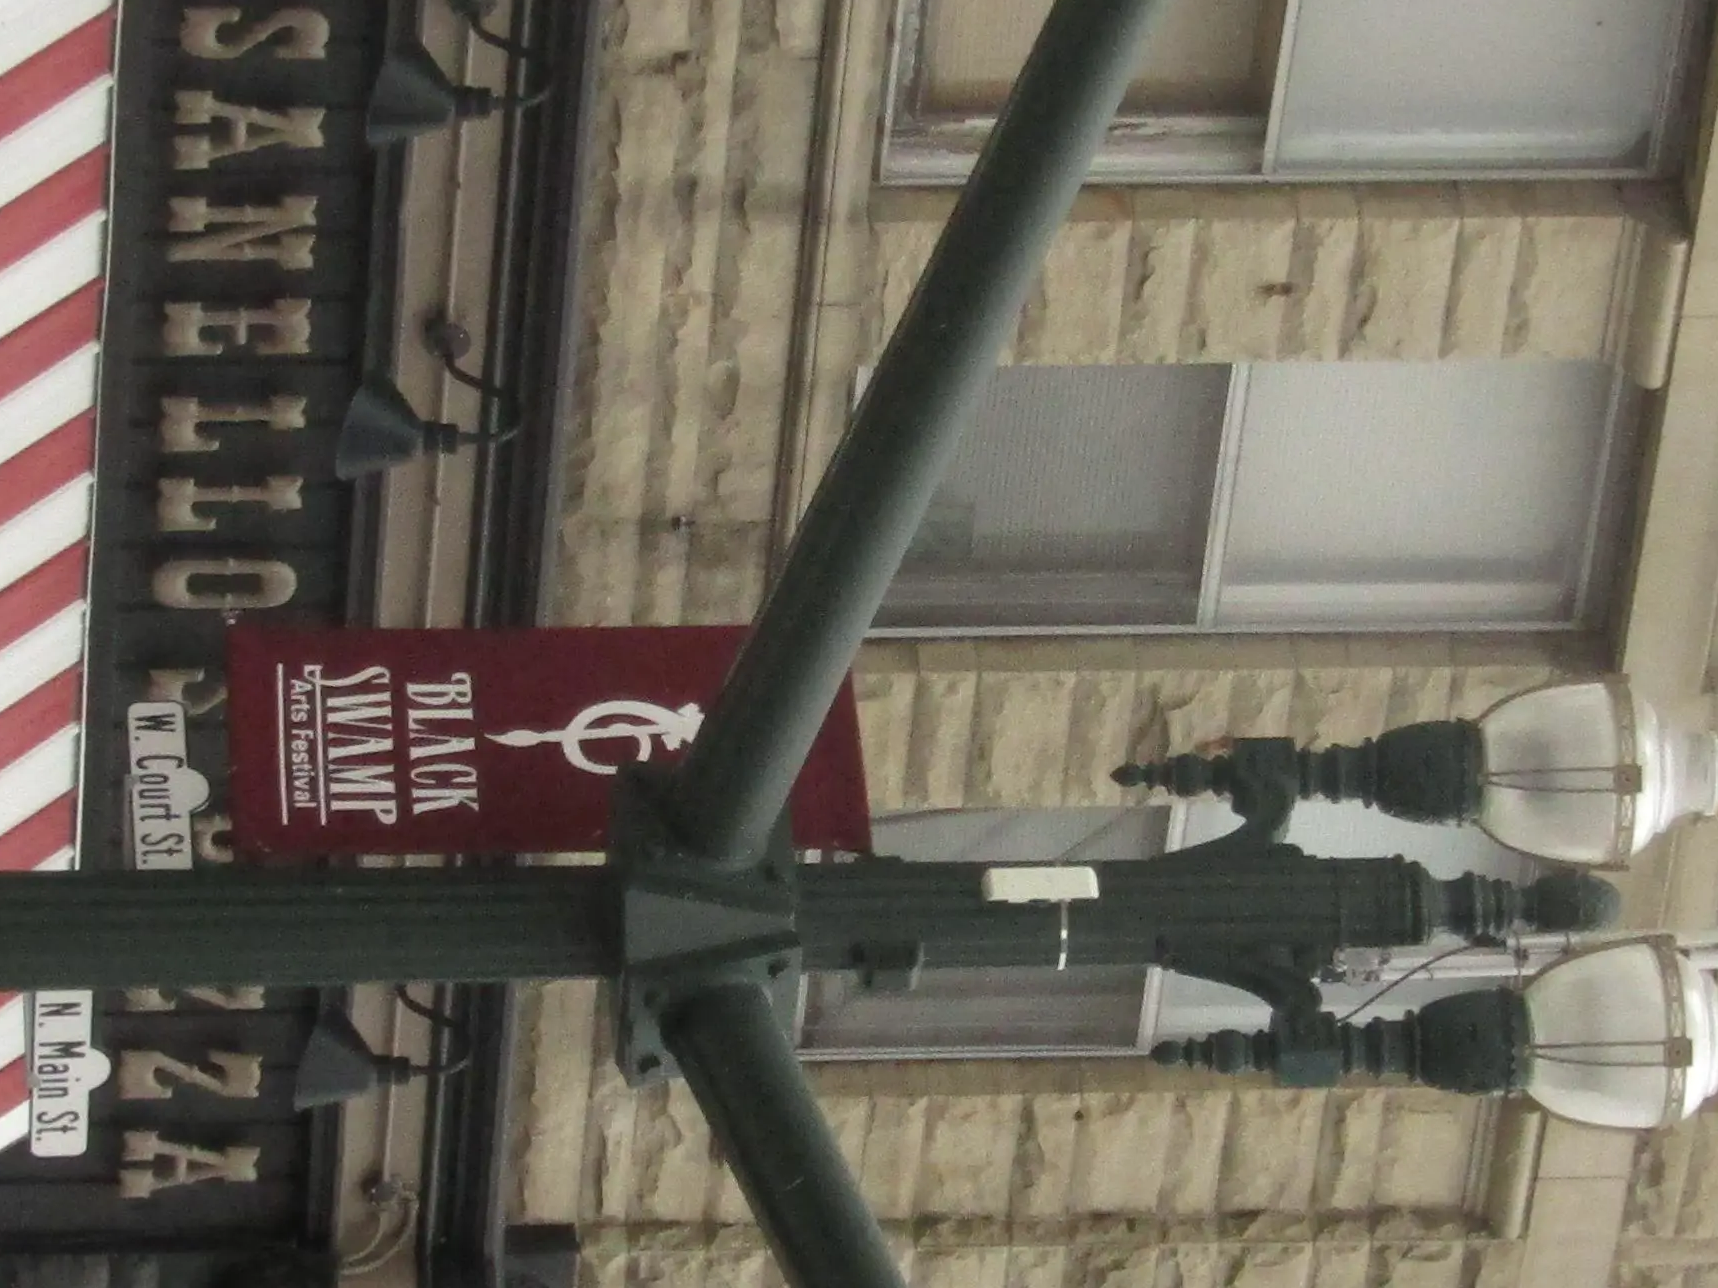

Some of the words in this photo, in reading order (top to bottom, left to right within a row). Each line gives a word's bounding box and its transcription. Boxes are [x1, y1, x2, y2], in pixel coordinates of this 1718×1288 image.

[290, 679, 314, 722] Arts
[134, 713, 177, 742] W.
[303, 665, 398, 825] SWAMP
[406, 672, 479, 815] BLACK
[136, 755, 185, 822] Court
[291, 729, 317, 808] Festival
[140, 833, 185, 865] St.
[37, 1002, 82, 1028] N.
[36, 1041, 86, 1099] Main
[35, 1111, 81, 1142] St.
